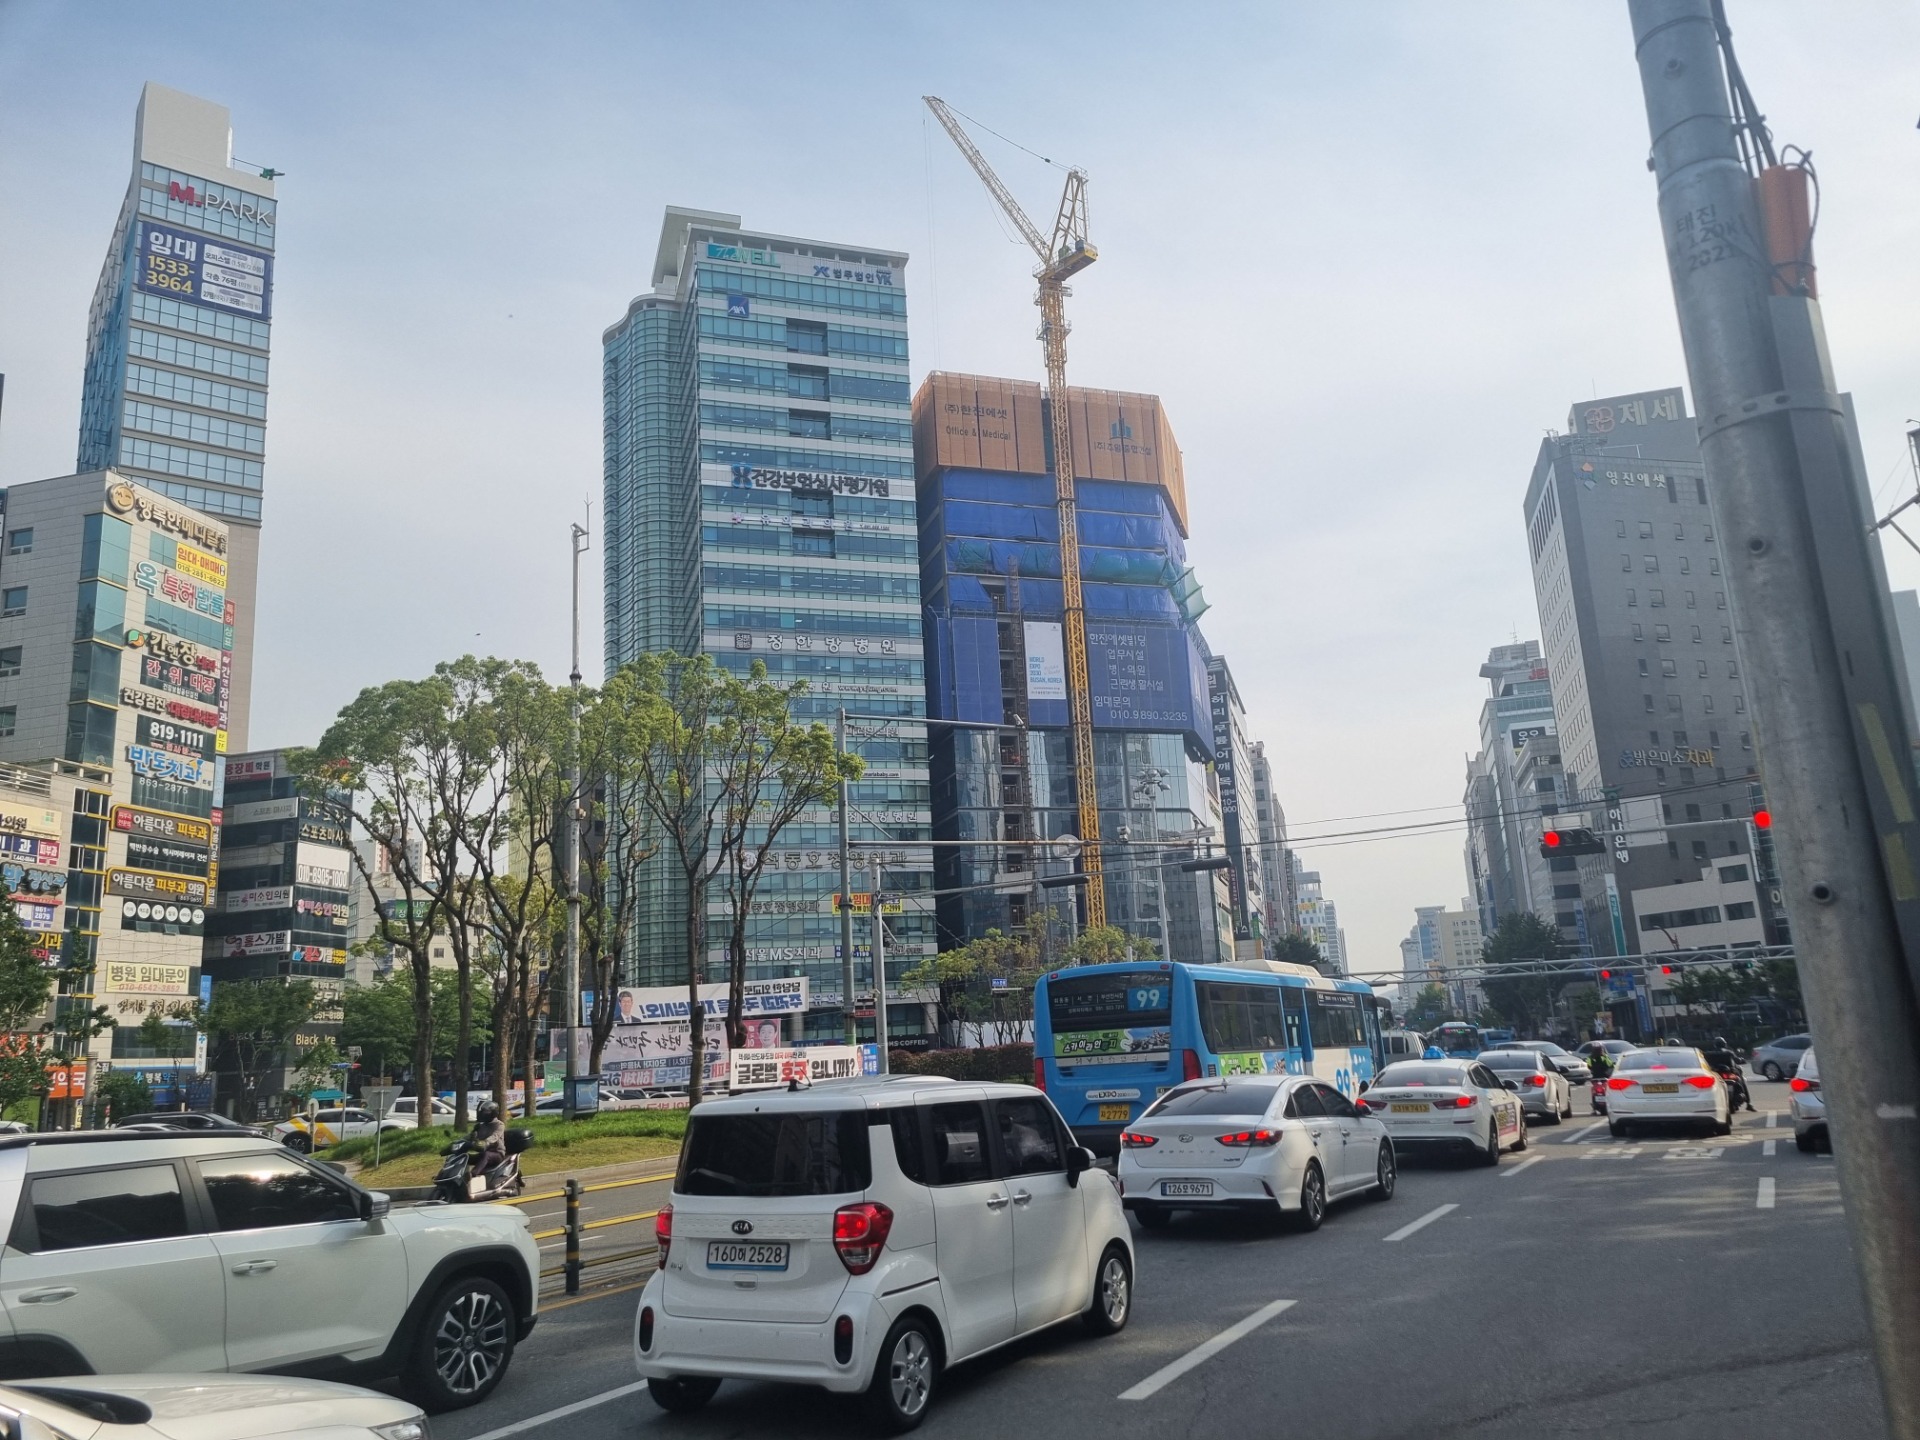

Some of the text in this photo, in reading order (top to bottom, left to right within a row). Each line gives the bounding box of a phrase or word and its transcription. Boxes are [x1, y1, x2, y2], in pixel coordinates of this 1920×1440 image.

[150, 231, 197, 262] 임대
[205, 251, 231, 265] 오피스텔
[147, 270, 194, 294] 3964
[221, 276, 237, 287] 76평
[833, 268, 875, 283] 법무법인
[876, 274, 893, 286] YK
[728, 305, 747, 315] AXA
[945, 425, 969, 437] Office
[982, 430, 1011, 441] Medical
[751, 468, 889, 498] 건강보험심사평가원
[1606, 470, 1667, 489] 영진에셋
[767, 633, 897, 655] 정한방병원
[1089, 633, 1147, 647] 한진에셋빌딩
[1107, 648, 1144, 661] 업무시설
[1110, 679, 1164, 692] 근린생활시설
[123, 687, 167, 712] 건강검진
[1094, 695, 1131, 708] 임대문의
[128, 746, 203, 782] 반도치과
[1633, 749, 1715, 768] 밝은미소치과
[139, 777, 189, 794] 863-2875
[133, 814, 208, 840] 아름다운 피부과
[112, 873, 205, 896] 아름다운 피부과 의원
[298, 864, 348, 887] 010-8905-1000
[111, 965, 187, 984] 병원 임대문의
[1136, 989, 1160, 1008] 99
[295, 1033, 319, 1046] Black
[811, 1057, 856, 1080] 입니까?
[1190, 1184, 1210, 1193] 9671
[733, 1223, 751, 1231] KIA
